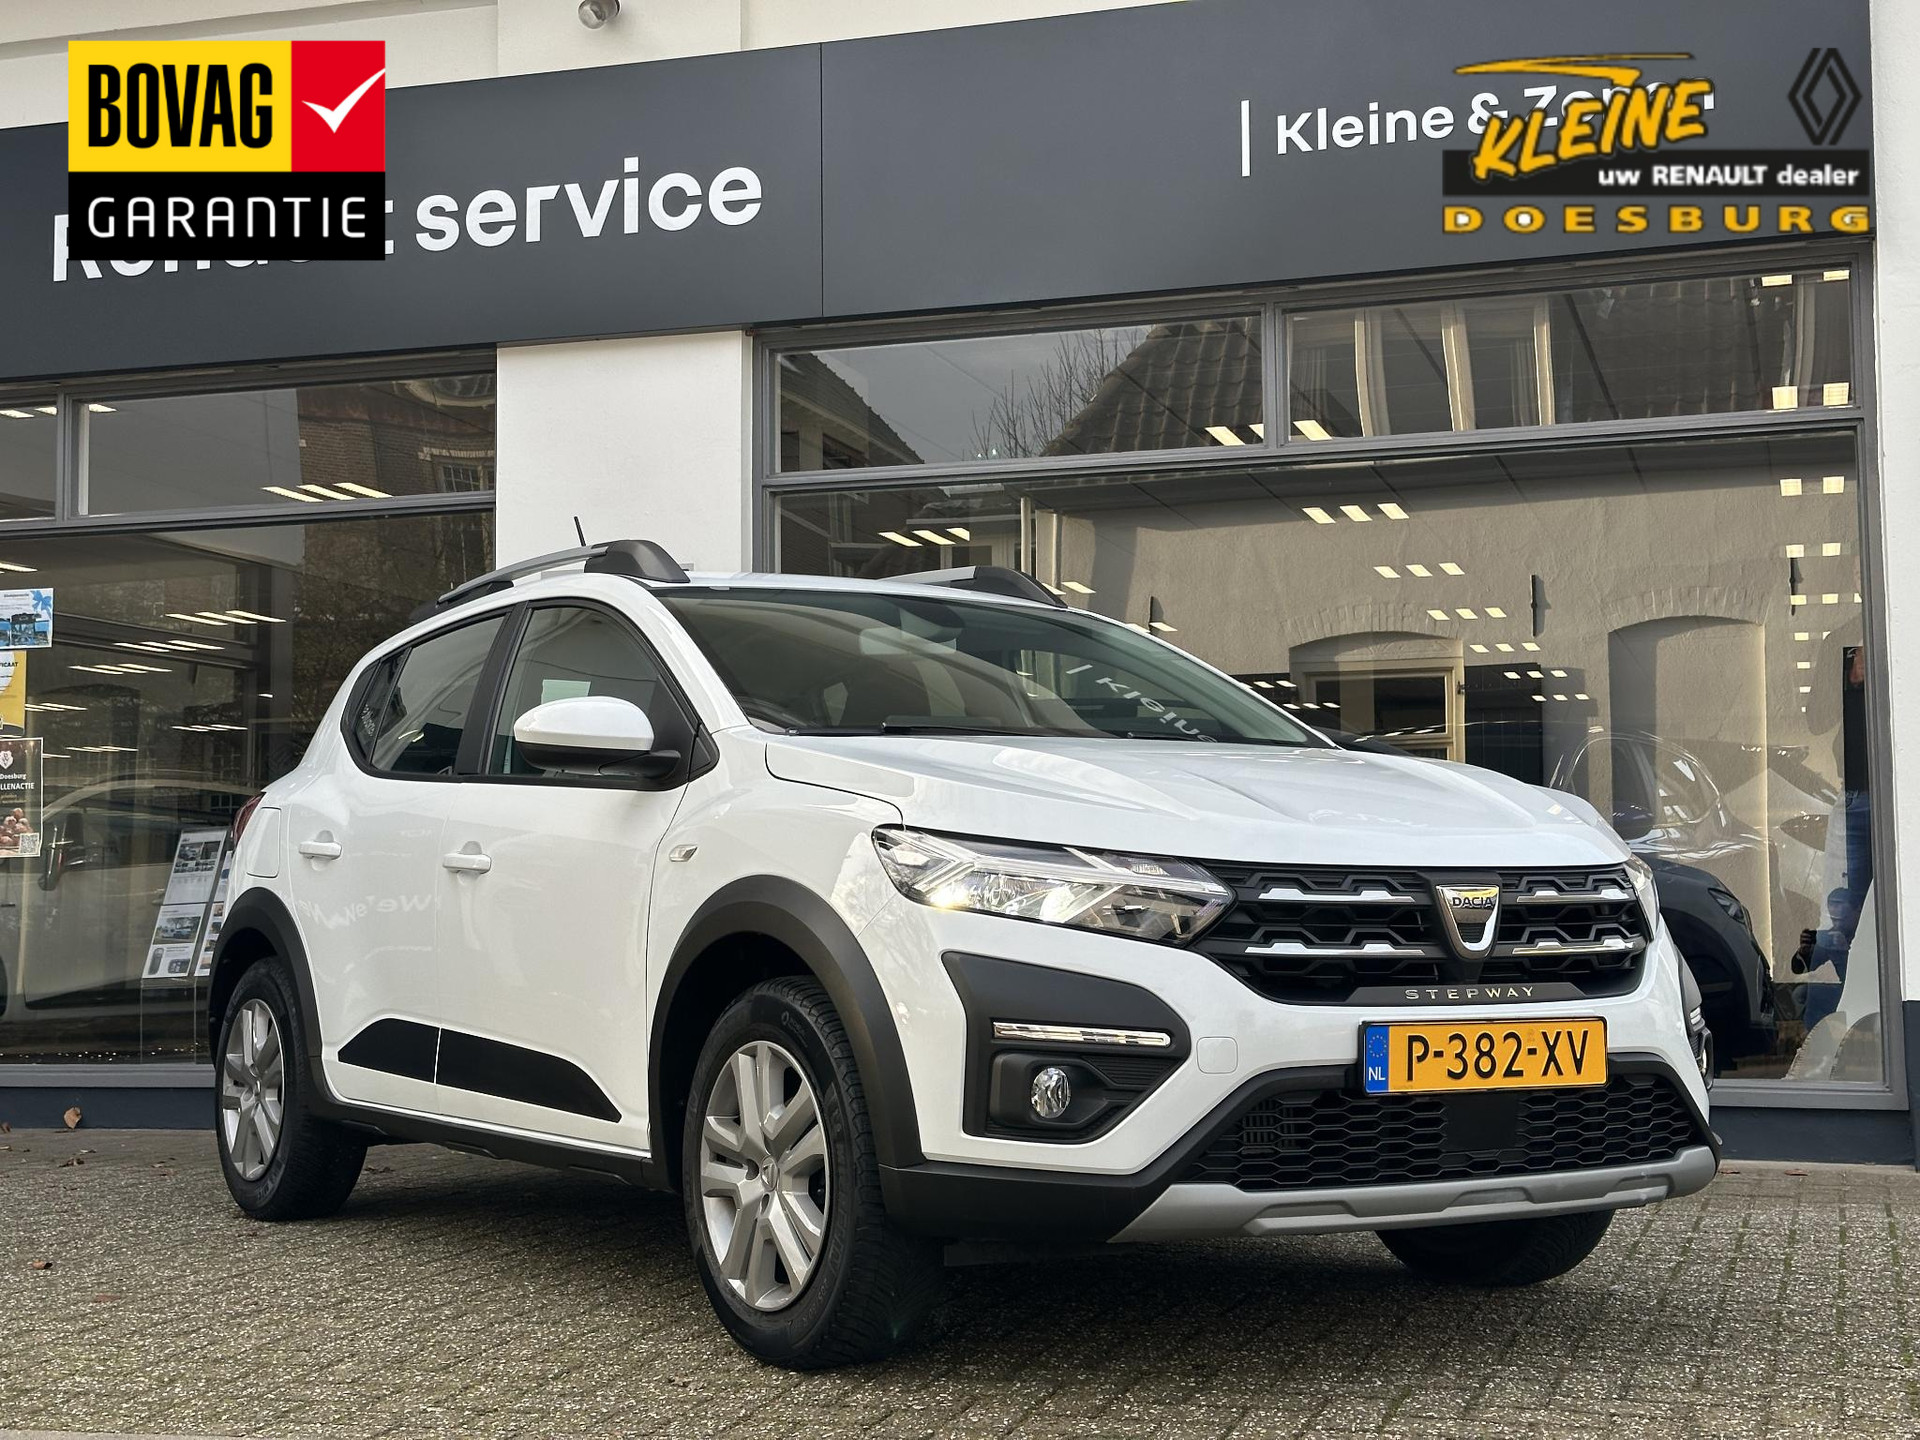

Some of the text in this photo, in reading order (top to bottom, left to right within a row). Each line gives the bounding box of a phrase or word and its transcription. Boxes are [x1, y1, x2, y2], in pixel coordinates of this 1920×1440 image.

[1276, 101, 1455, 156] Kleine
[415, 156, 763, 252] service
[1452, 895, 1496, 909] DACIA
[1405, 986, 1534, 1000] STEPWAY
[1406, 1029, 1590, 1082] P-382-XV
[1367, 1065, 1387, 1082] NL
